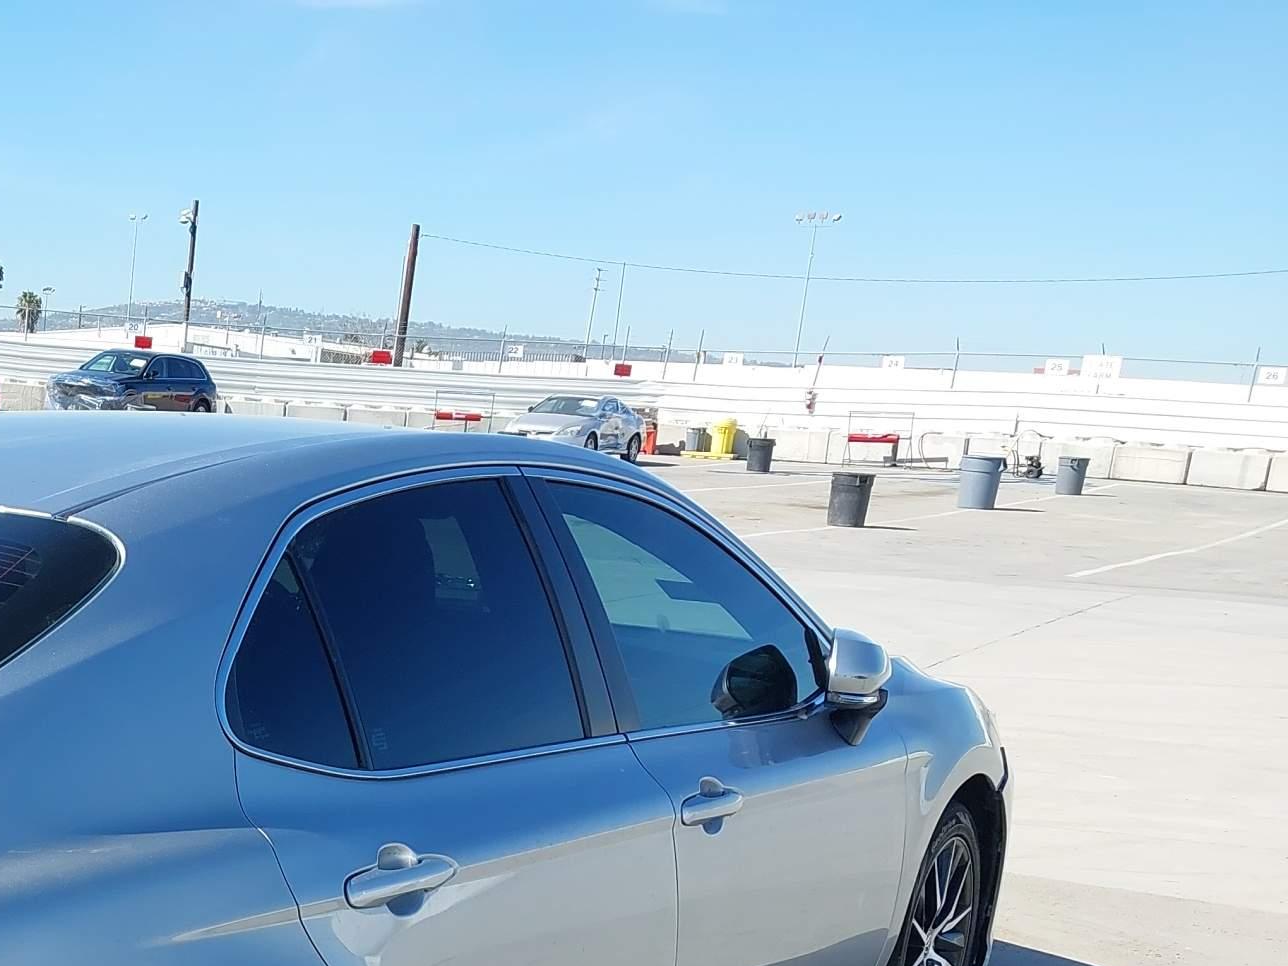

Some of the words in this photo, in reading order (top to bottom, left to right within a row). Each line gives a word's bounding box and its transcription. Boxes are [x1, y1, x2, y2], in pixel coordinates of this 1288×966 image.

[128, 323, 139, 331] 20
[508, 346, 519, 354] 22
[887, 359, 900, 368] 24
[1050, 362, 1063, 371] 25
[1264, 371, 1279, 381] 26
